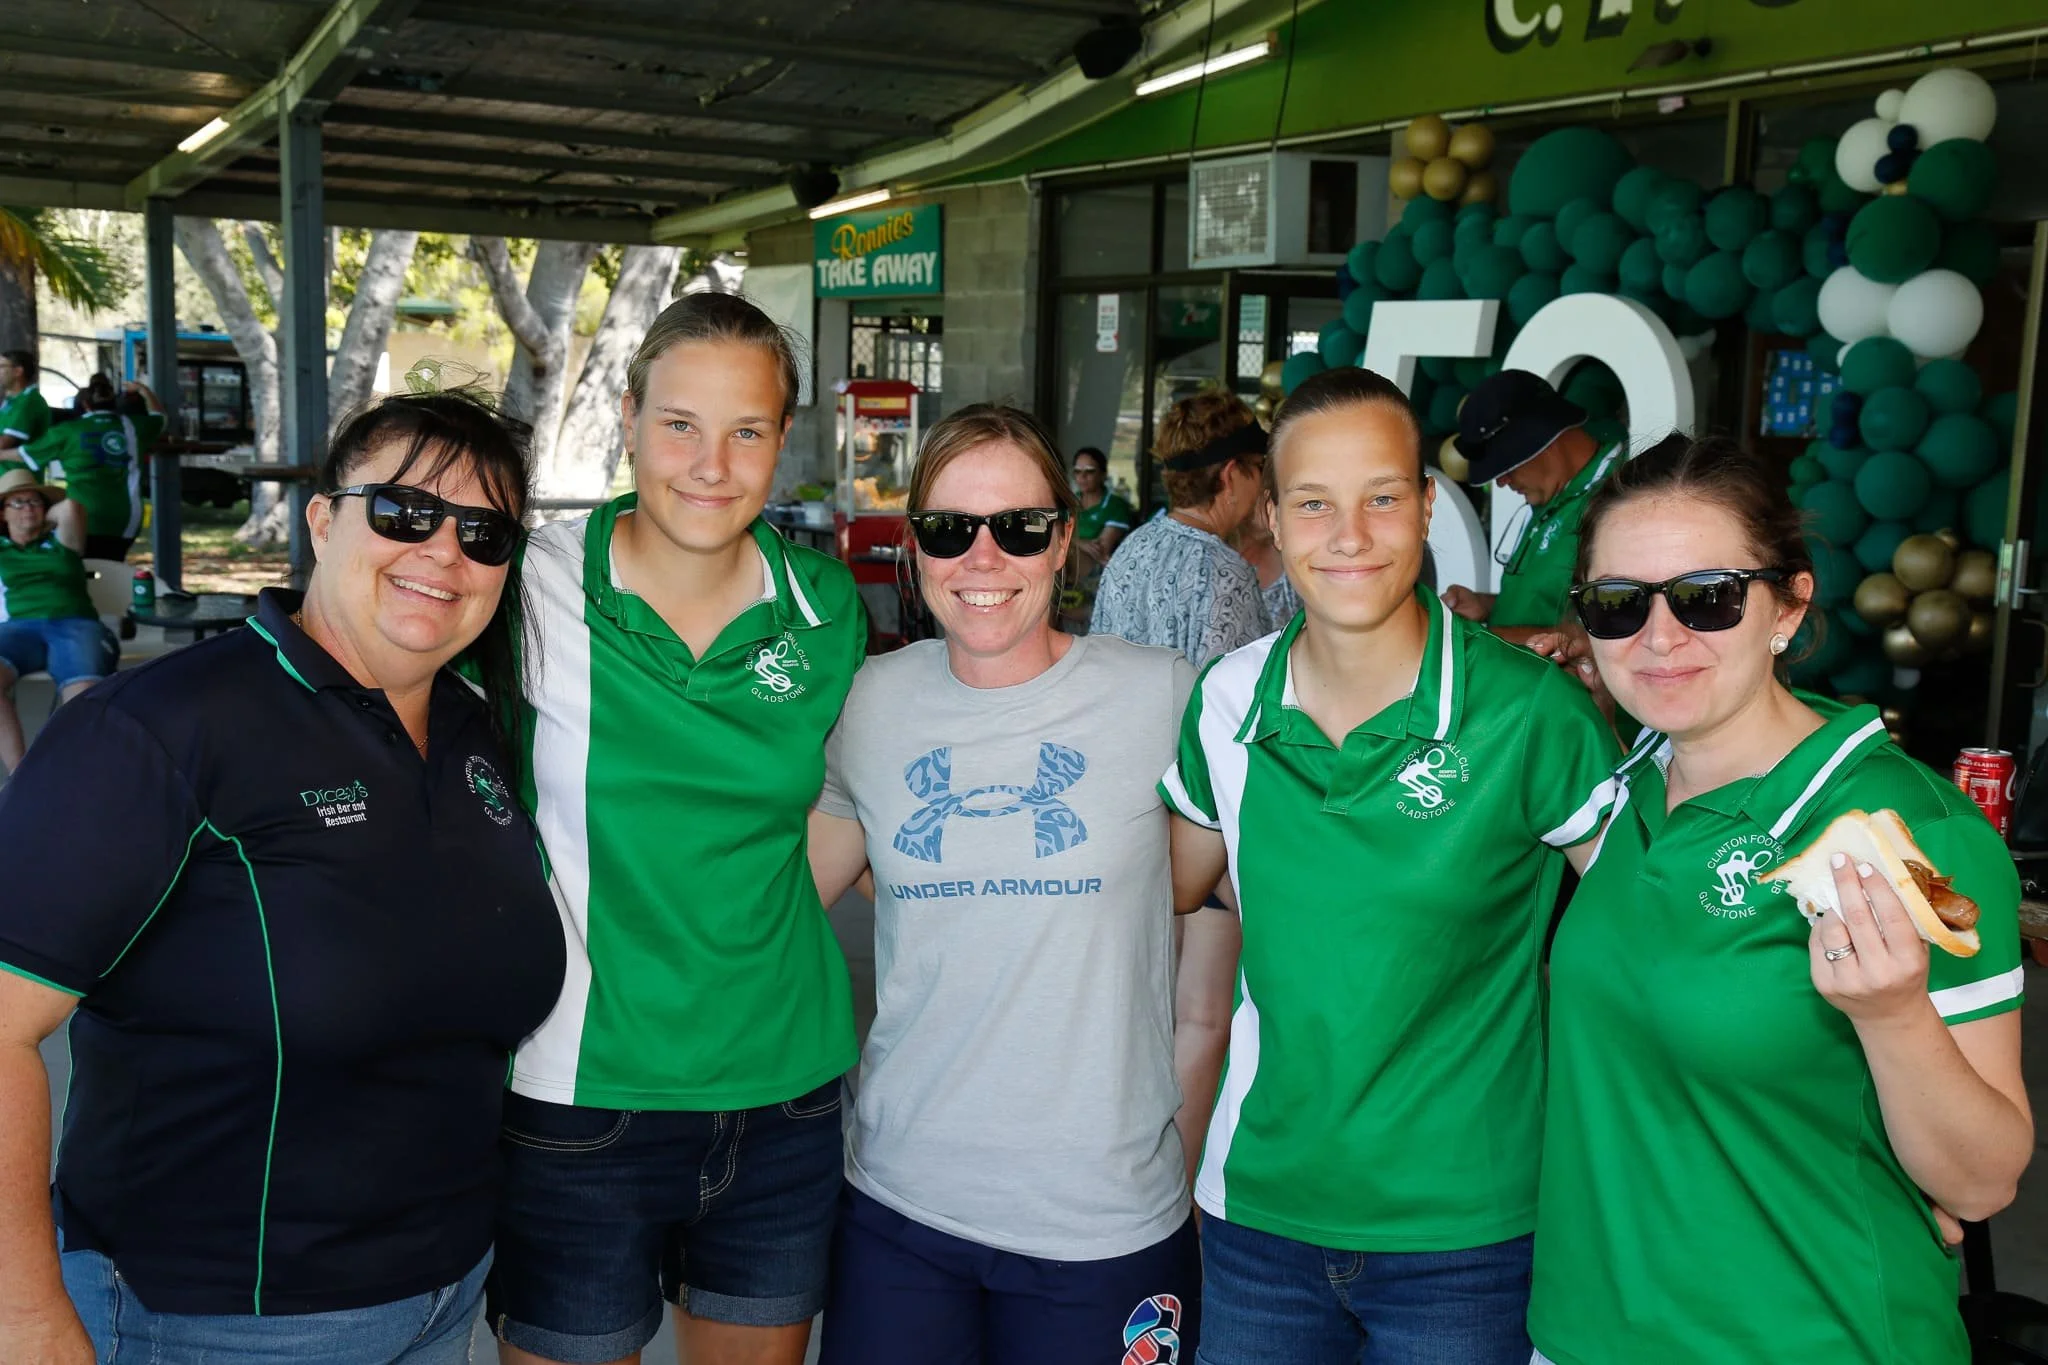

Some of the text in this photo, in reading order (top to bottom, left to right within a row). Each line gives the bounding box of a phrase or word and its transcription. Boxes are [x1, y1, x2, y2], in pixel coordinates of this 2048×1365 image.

[831, 211, 914, 263] Ronnies
[816, 251, 937, 290] TAKE AWAY
[797, 648, 811, 672] CLUB
[751, 684, 806, 703] GLADSTONE
[1458, 757, 1470, 783] CLUB
[1973, 761, 2001, 769] CLASSIC
[300, 779, 369, 807] Dicey's
[316, 800, 366, 817] Irish Bar and
[325, 812, 367, 828] Restaurant
[1396, 798, 1456, 820] GLADSTONE
[1707, 835, 1747, 869] CLINTON
[889, 878, 1102, 900] UNDER ARMOUR
[1699, 891, 1757, 919] GLADSTONE
